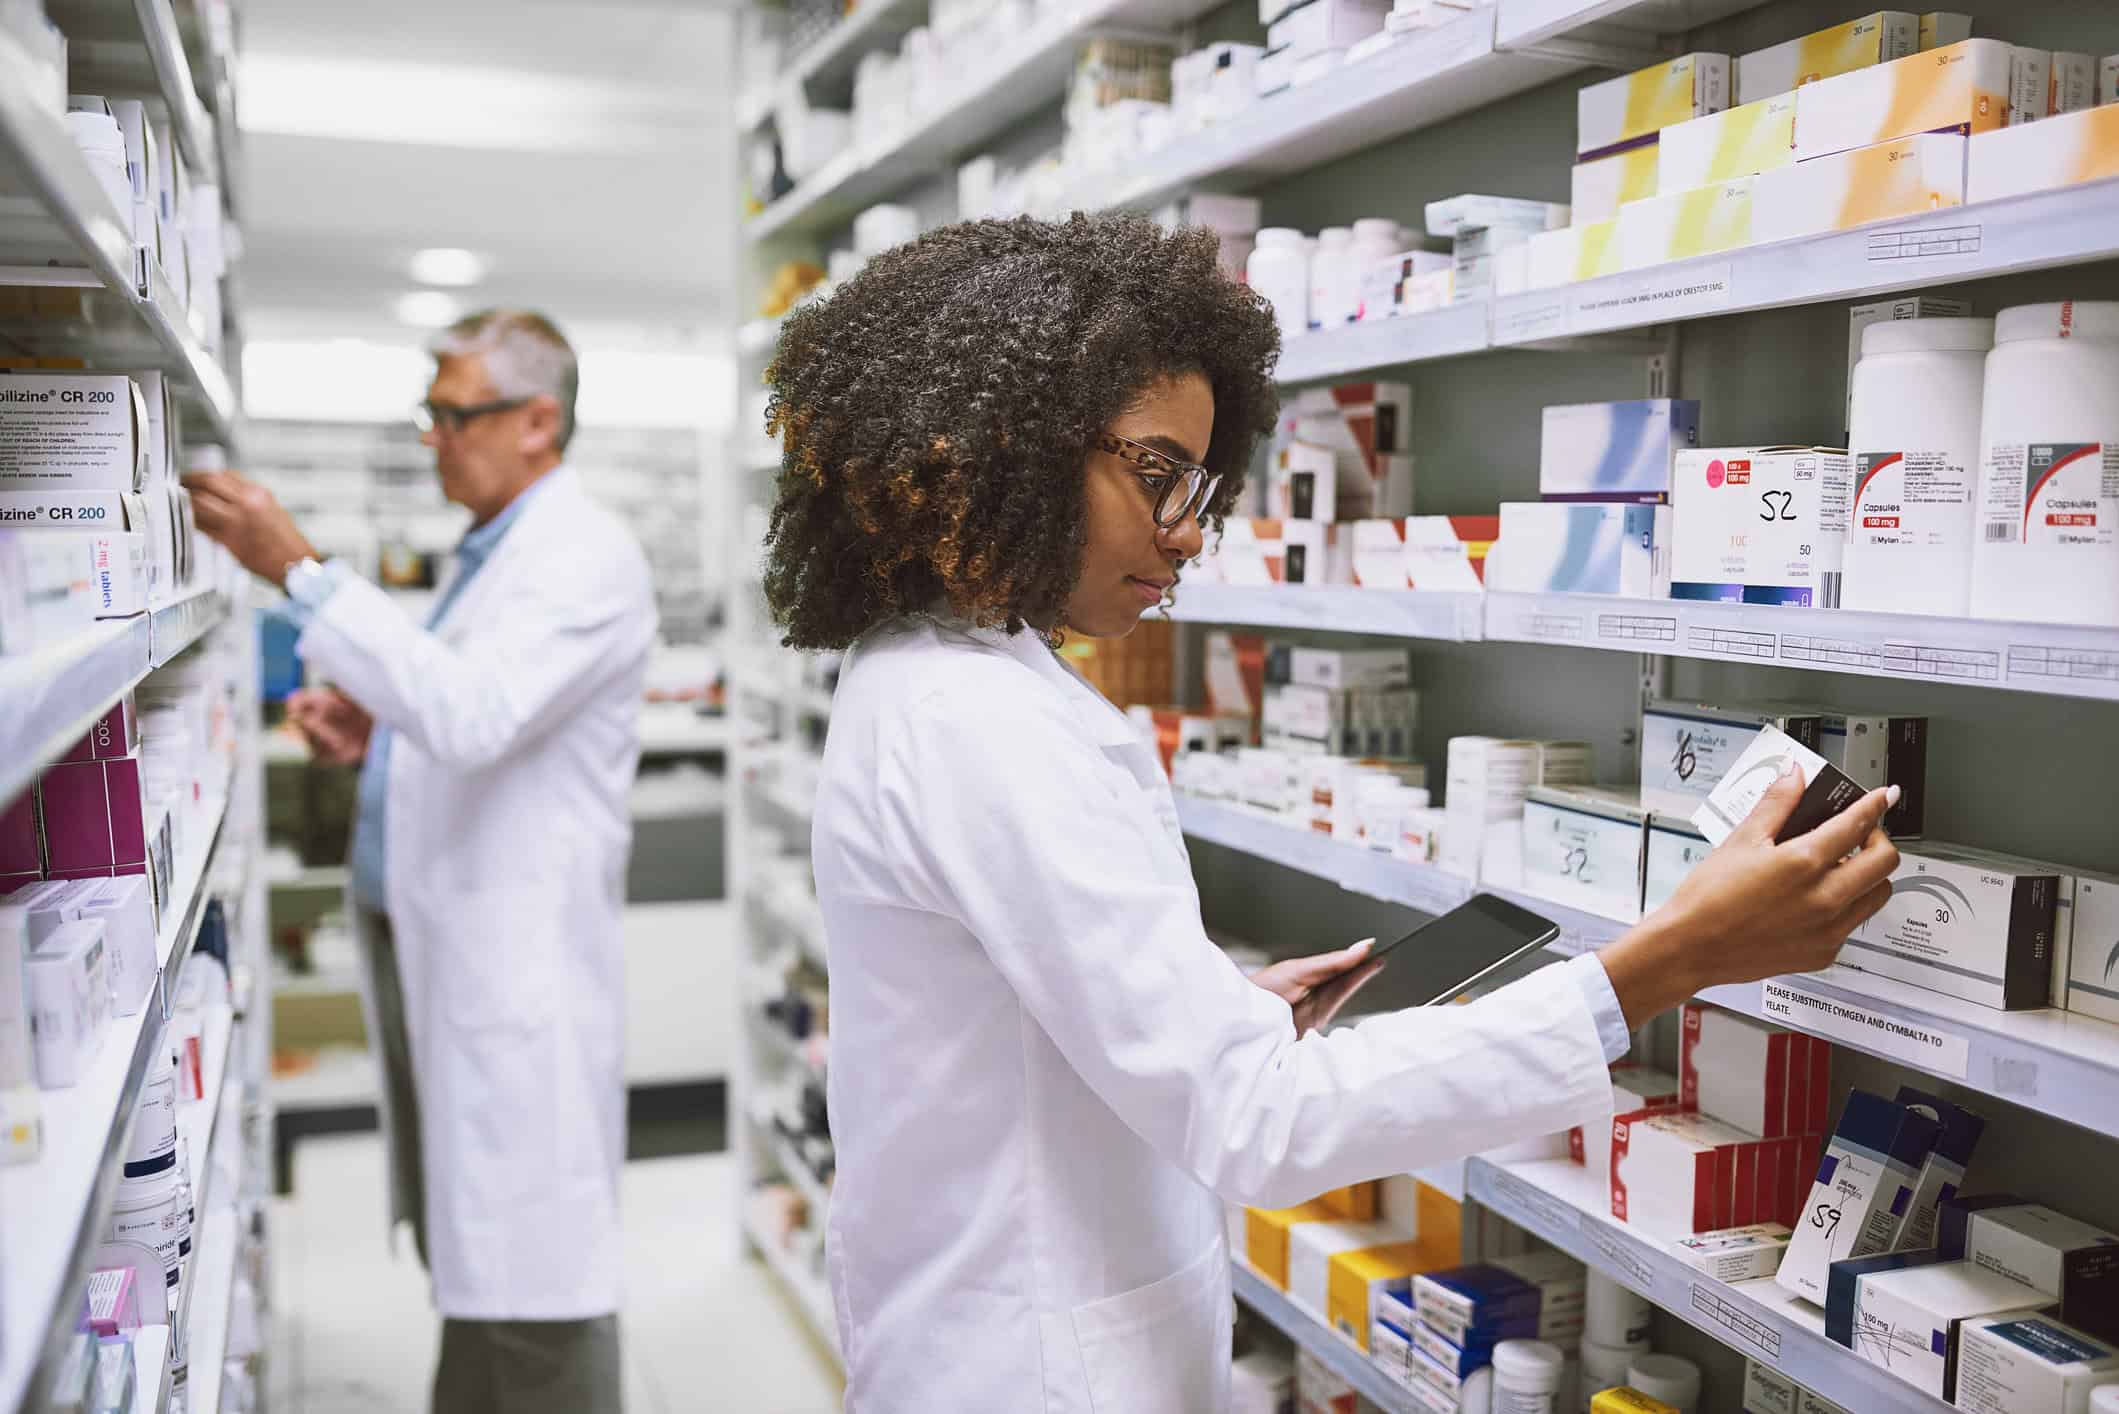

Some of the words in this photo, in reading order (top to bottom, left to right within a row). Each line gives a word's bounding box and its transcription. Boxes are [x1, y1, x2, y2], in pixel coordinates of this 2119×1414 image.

[61, 391, 84, 402] CR
[88, 391, 114, 402] 200
[1738, 475, 1749, 484] mg
[1863, 503, 1901, 512] Capsules
[2046, 499, 2097, 509] Capsules
[49, 507, 73, 520] CR
[78, 507, 105, 519] 200
[1867, 518, 1880, 527] 100
[1881, 519, 1896, 528] mg
[1877, 537, 1900, 545] Mylan
[2068, 535, 2097, 544] Mylan
[1799, 544, 1811, 555] 50
[100, 570, 112, 608] tablets
[1935, 909, 1949, 923] 30
[1766, 1000, 1791, 1016] YELATE.
[1766, 984, 1790, 1000] PLEASE
[1791, 992, 1833, 1014] SUBSTITUTE
[1833, 1006, 1866, 1024] CYMGEN
[1867, 1016, 1885, 1029] AND
[1886, 1021, 1929, 1043] CYMBALTA
[1931, 1036, 1943, 1047] TO
[1864, 1312, 1877, 1324] 150
[1877, 1320, 1889, 1332] mg
